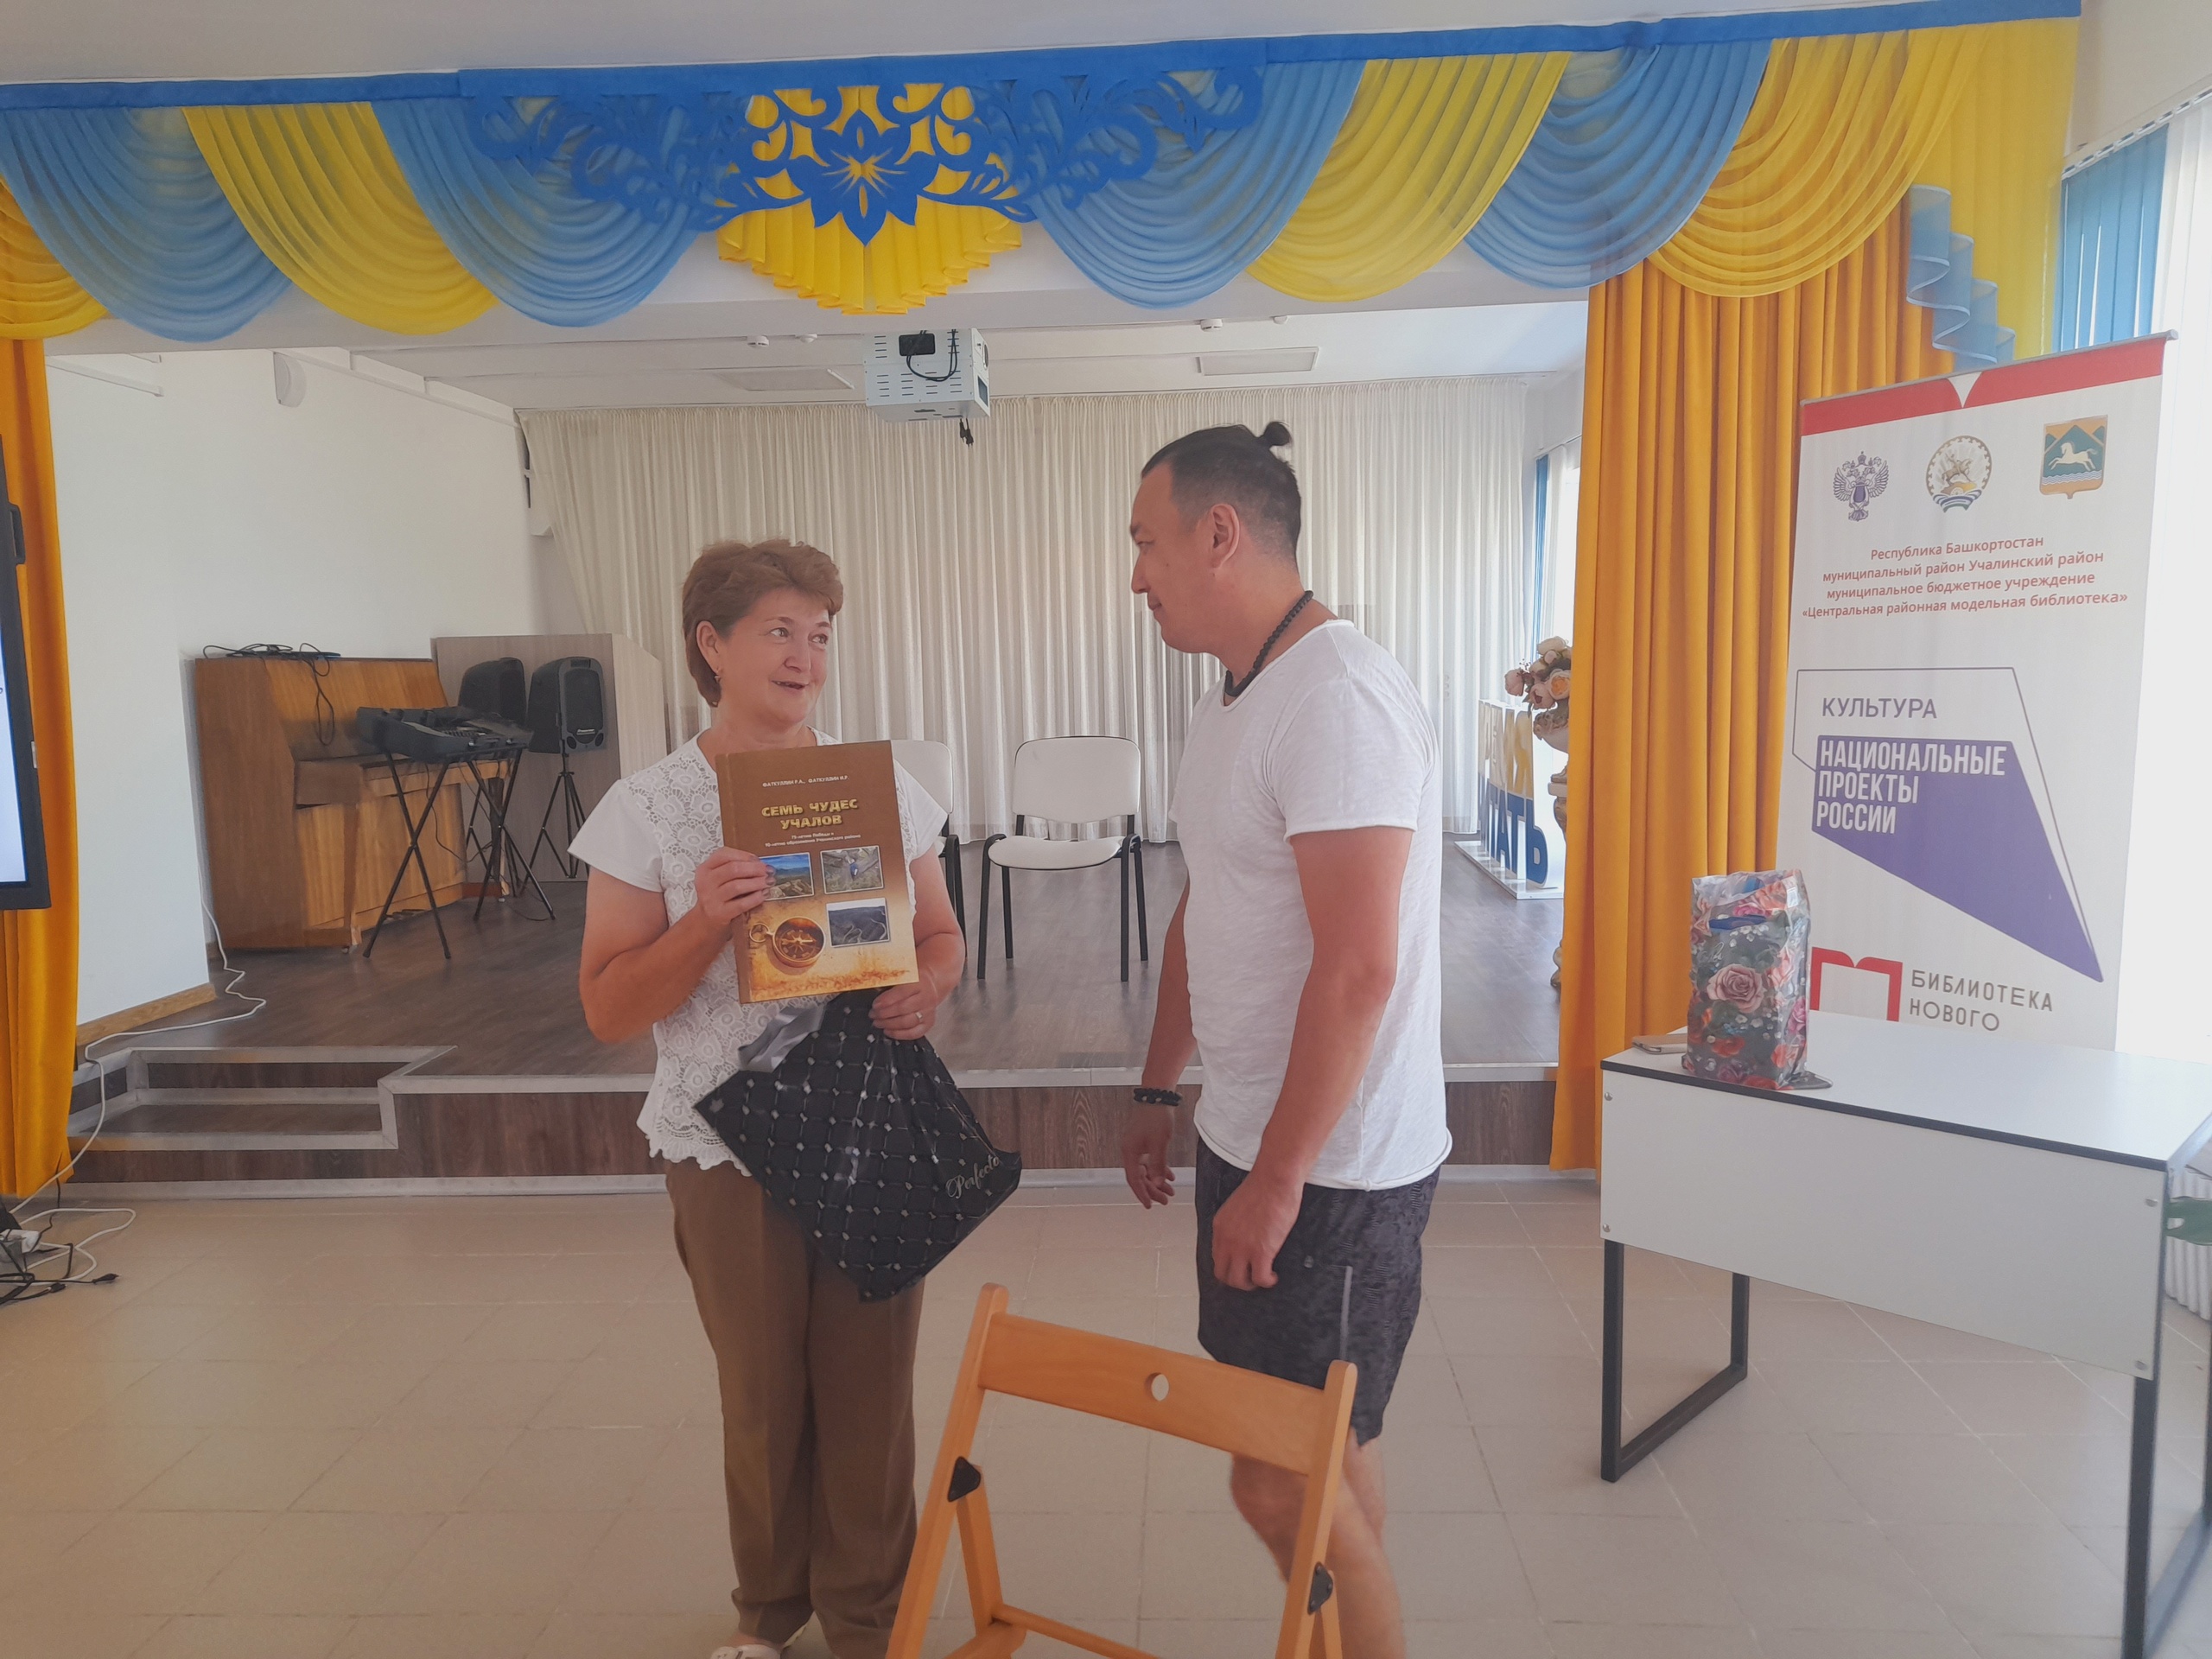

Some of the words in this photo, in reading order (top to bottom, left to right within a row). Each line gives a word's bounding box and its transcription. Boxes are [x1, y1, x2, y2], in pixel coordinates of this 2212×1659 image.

[1871, 545, 1942, 561] Республика
[1946, 537, 2044, 554] Башкортостан
[1822, 563, 1922, 584] муниципальный
[1925, 562, 1965, 577] район
[1968, 554, 2054, 572] Учалинский
[2057, 551, 2104, 569] район
[1827, 583, 1923, 601] муниципальное
[1927, 580, 2001, 594] бюджетное
[2005, 573, 2095, 591] учреждение
[1802, 605, 1884, 620] «Центральная
[1886, 601, 1947, 616] районная
[1950, 597, 2026, 613] модельная
[2030, 593, 2128, 607] библиотека»
[1821, 697, 1938, 719] КУЛЬТУРА
[1820, 740, 2007, 776] НАЦИОНАЛЬНЫЕ
[1818, 770, 1919, 804] ПРОЕКТЫ
[761, 804, 804, 817] СЕМЬ
[810, 798, 858, 812] ЧУДЕС
[780, 815, 842, 830] УЧАЛОВ
[1816, 800, 1897, 834] РОССИИ
[1911, 969, 2053, 1012] БИБЛИОТЕКА
[1910, 997, 2000, 1031] НОВОГО
